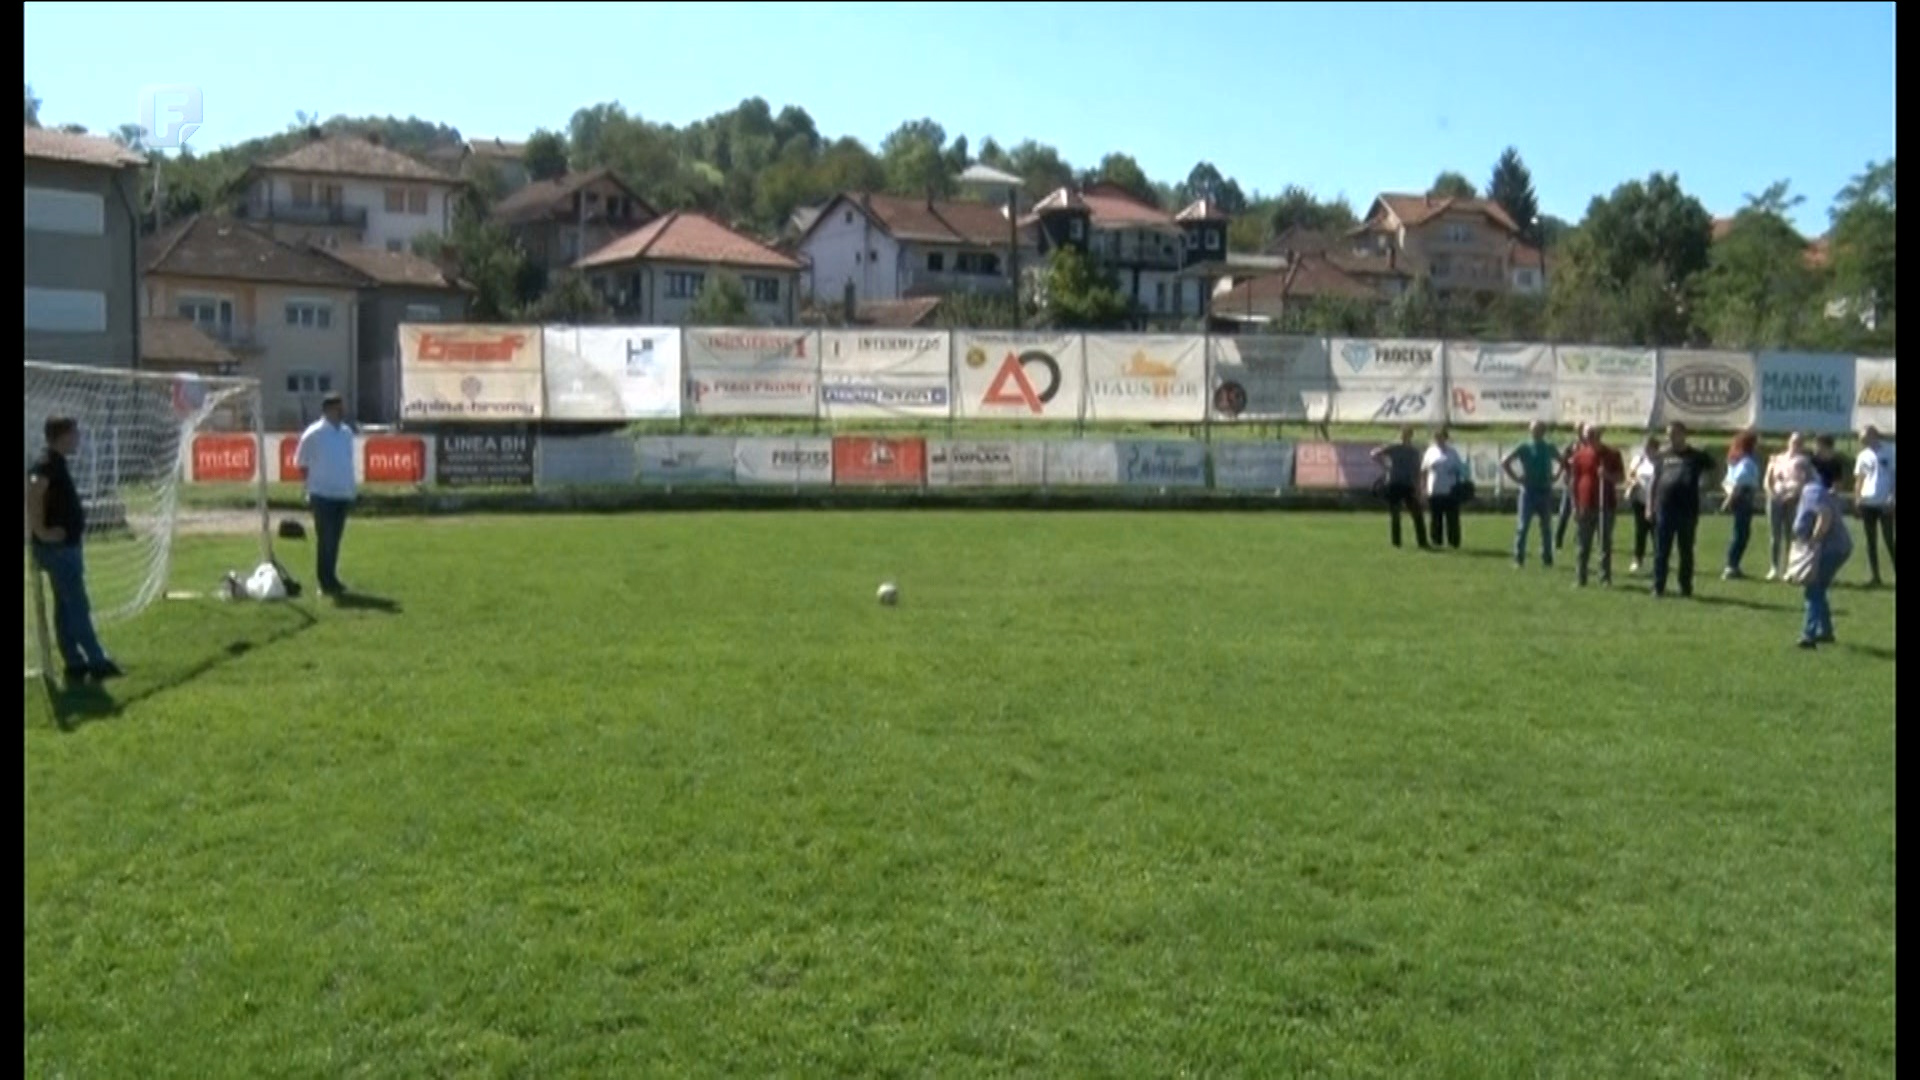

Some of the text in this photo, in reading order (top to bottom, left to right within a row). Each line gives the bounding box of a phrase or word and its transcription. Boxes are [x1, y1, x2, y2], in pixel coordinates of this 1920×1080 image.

[1684, 376, 1731, 394] SILK
[1762, 371, 1823, 390] MANN
[1762, 392, 1846, 411] HUMMEL
[444, 437, 497, 451] LINEA
[200, 449, 249, 468] mitel
[370, 452, 418, 468] mitel
